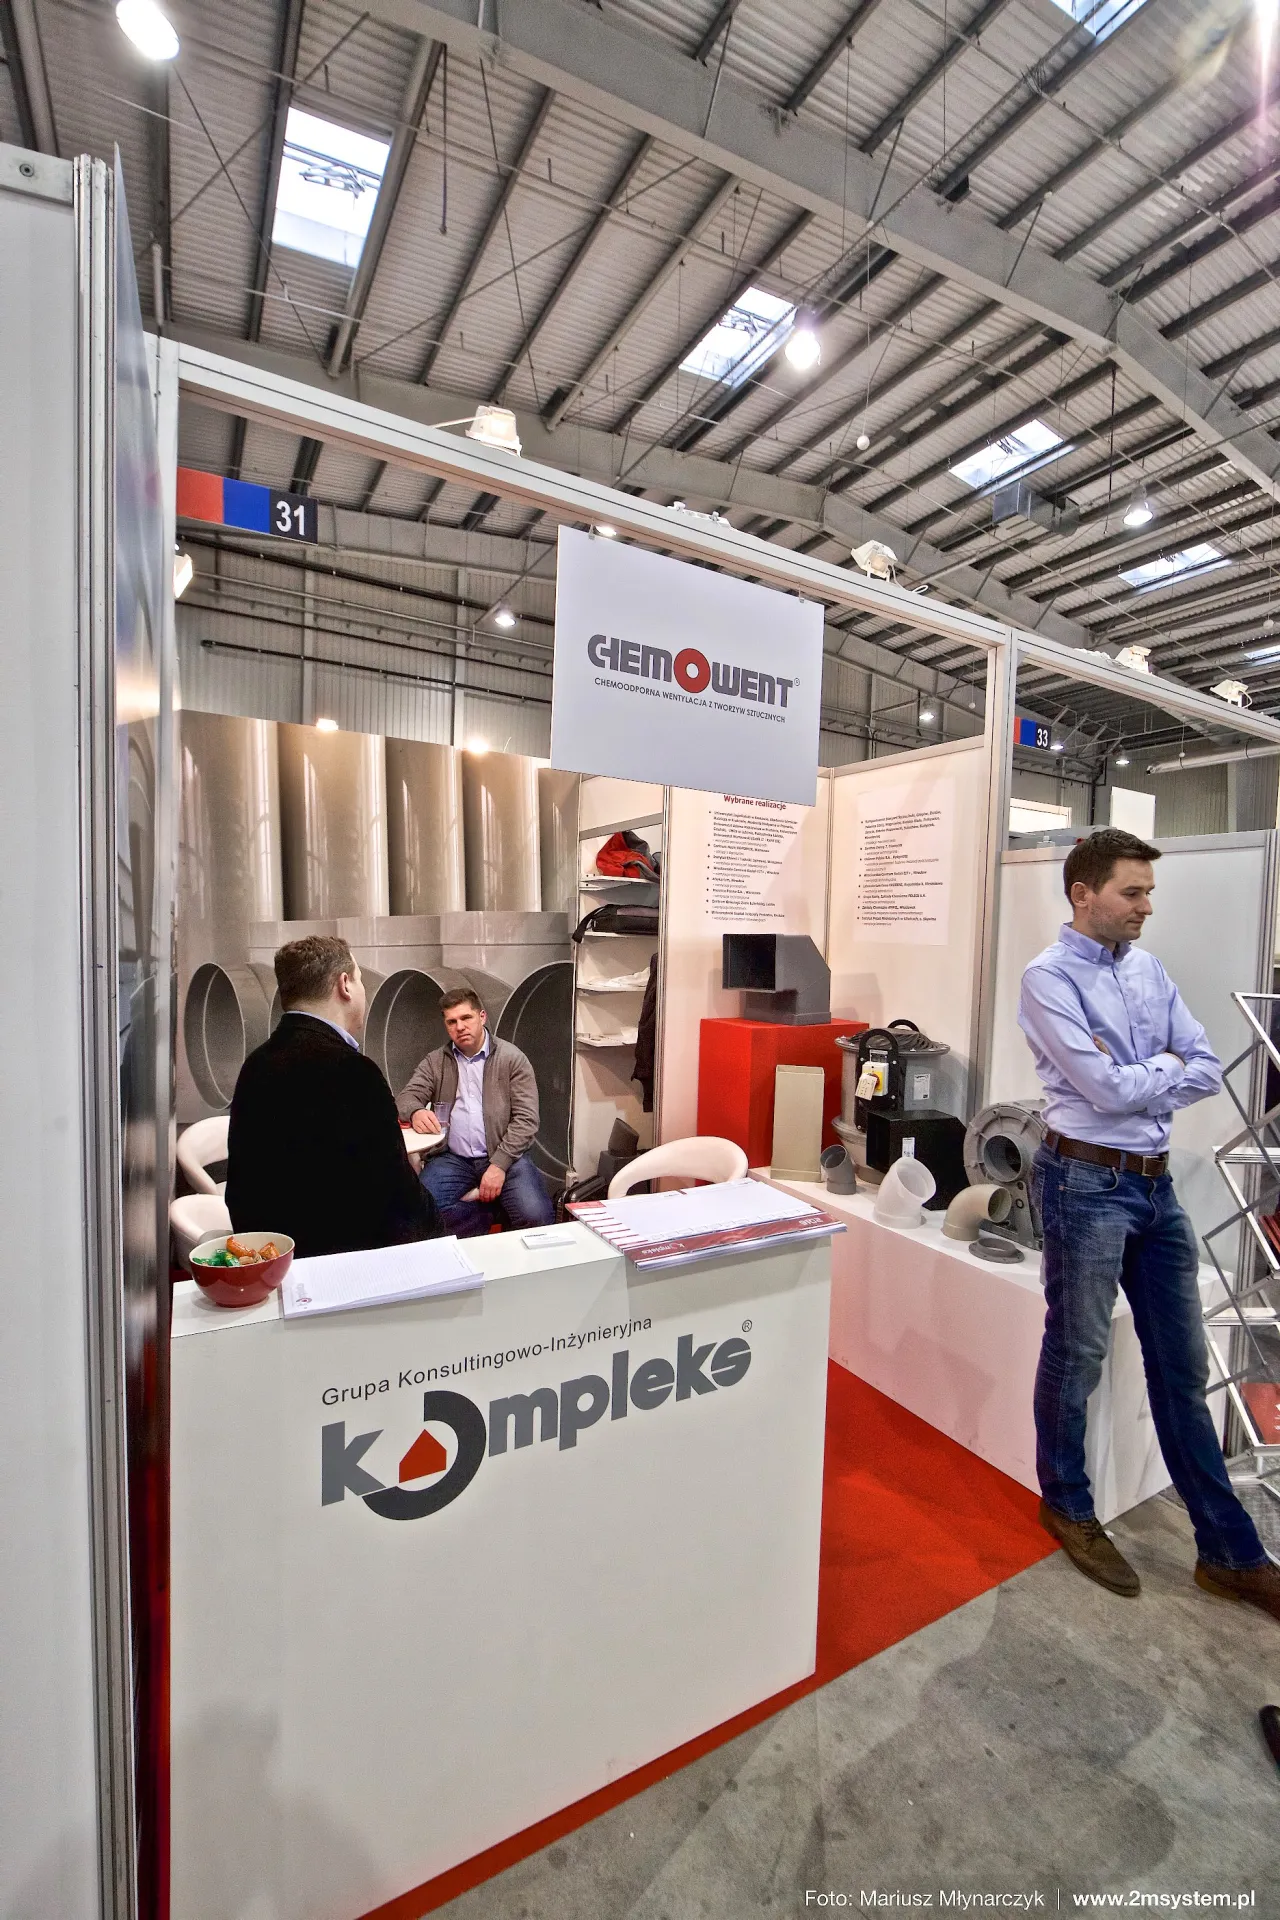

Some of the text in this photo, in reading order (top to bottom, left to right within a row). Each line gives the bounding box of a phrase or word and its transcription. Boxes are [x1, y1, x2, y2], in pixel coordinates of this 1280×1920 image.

[275, 500, 305, 536] 31
[594, 677, 786, 723] CHEMOODPORNA WENTYLACJA Z TWORZYW SZTUCZNYCH
[1036, 728, 1049, 748] 33
[723, 794, 787, 811] Wybrane realizacje
[321, 1318, 653, 1406] Grupa Konsultingowo-Inżynieryjna
